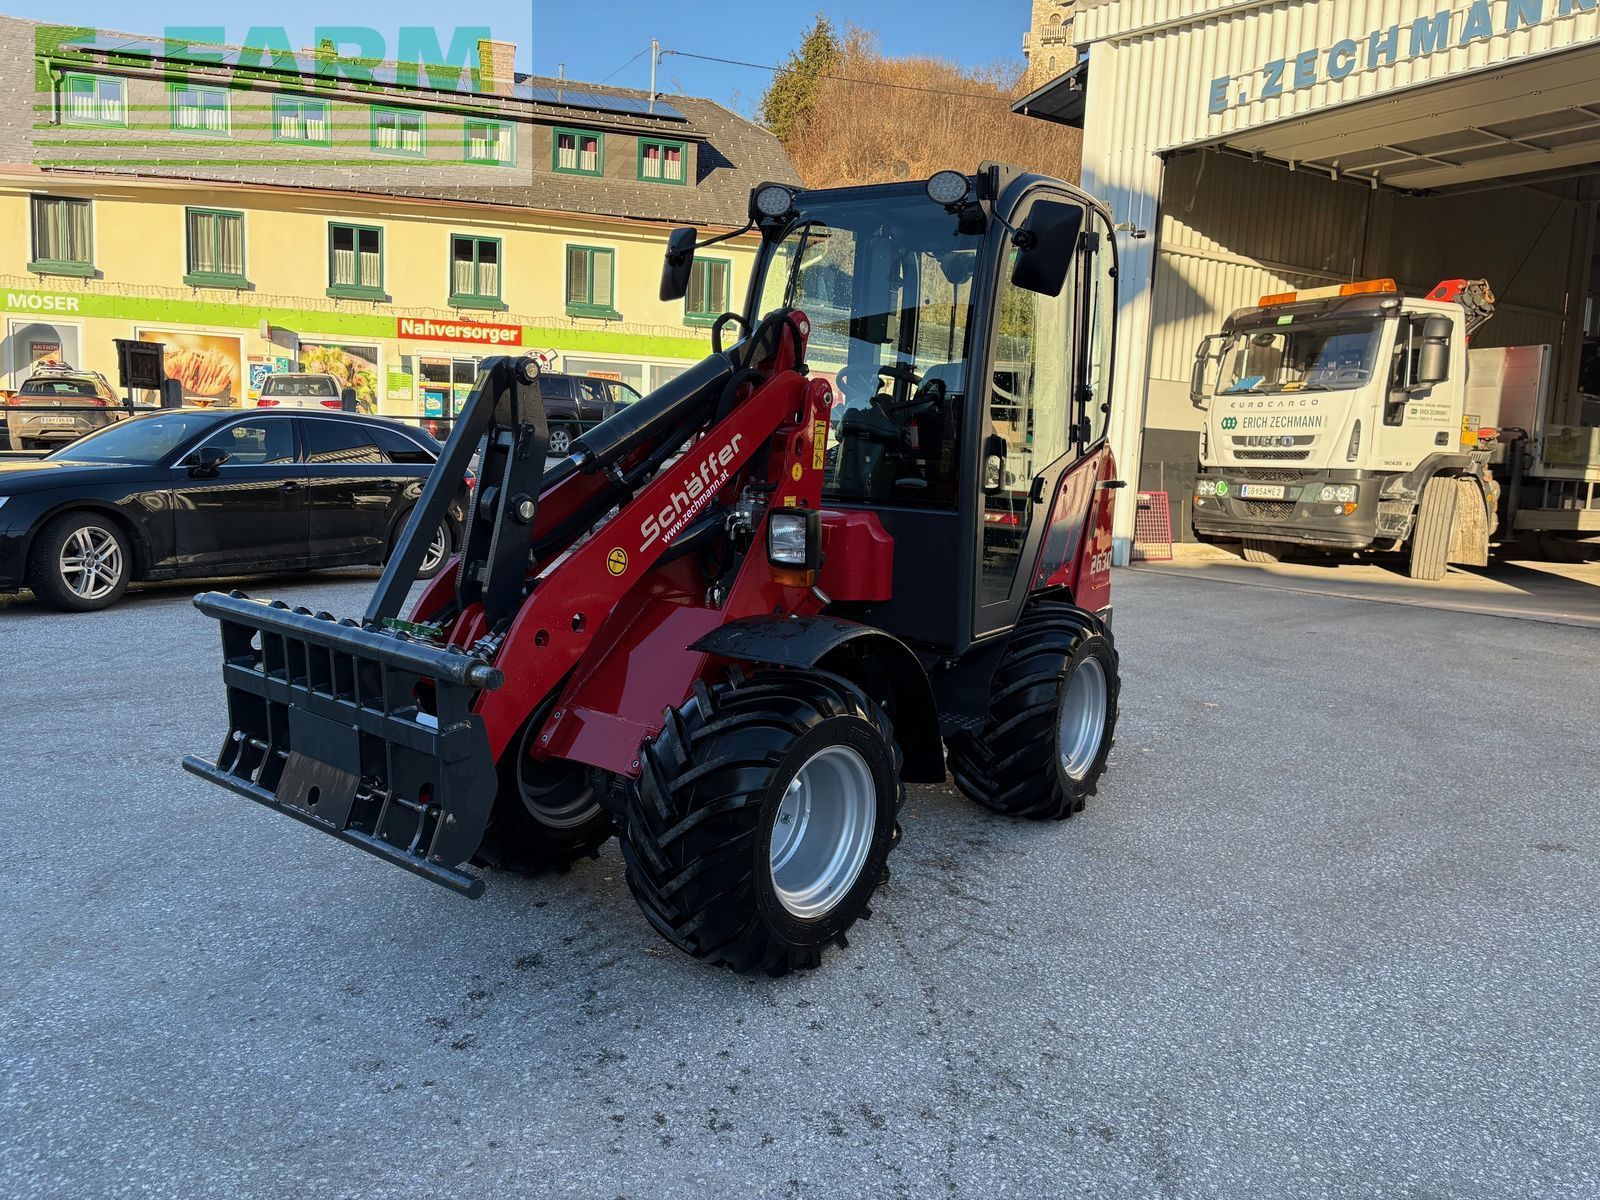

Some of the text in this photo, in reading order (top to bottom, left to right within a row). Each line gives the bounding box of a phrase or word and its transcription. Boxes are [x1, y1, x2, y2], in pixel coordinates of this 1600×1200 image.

[7, 293, 80, 311] MOSER
[400, 319, 519, 343] Nahversorger
[1230, 399, 1319, 409] EUROCARGO
[1242, 416, 1268, 429] ERICH
[1269, 415, 1322, 428] ZECHMANN
[1243, 435, 1295, 447] IVECO
[640, 433, 742, 552] Schäffer
[662, 469, 730, 543] www.zechmann.at
[1090, 551, 1112, 575] 2630
